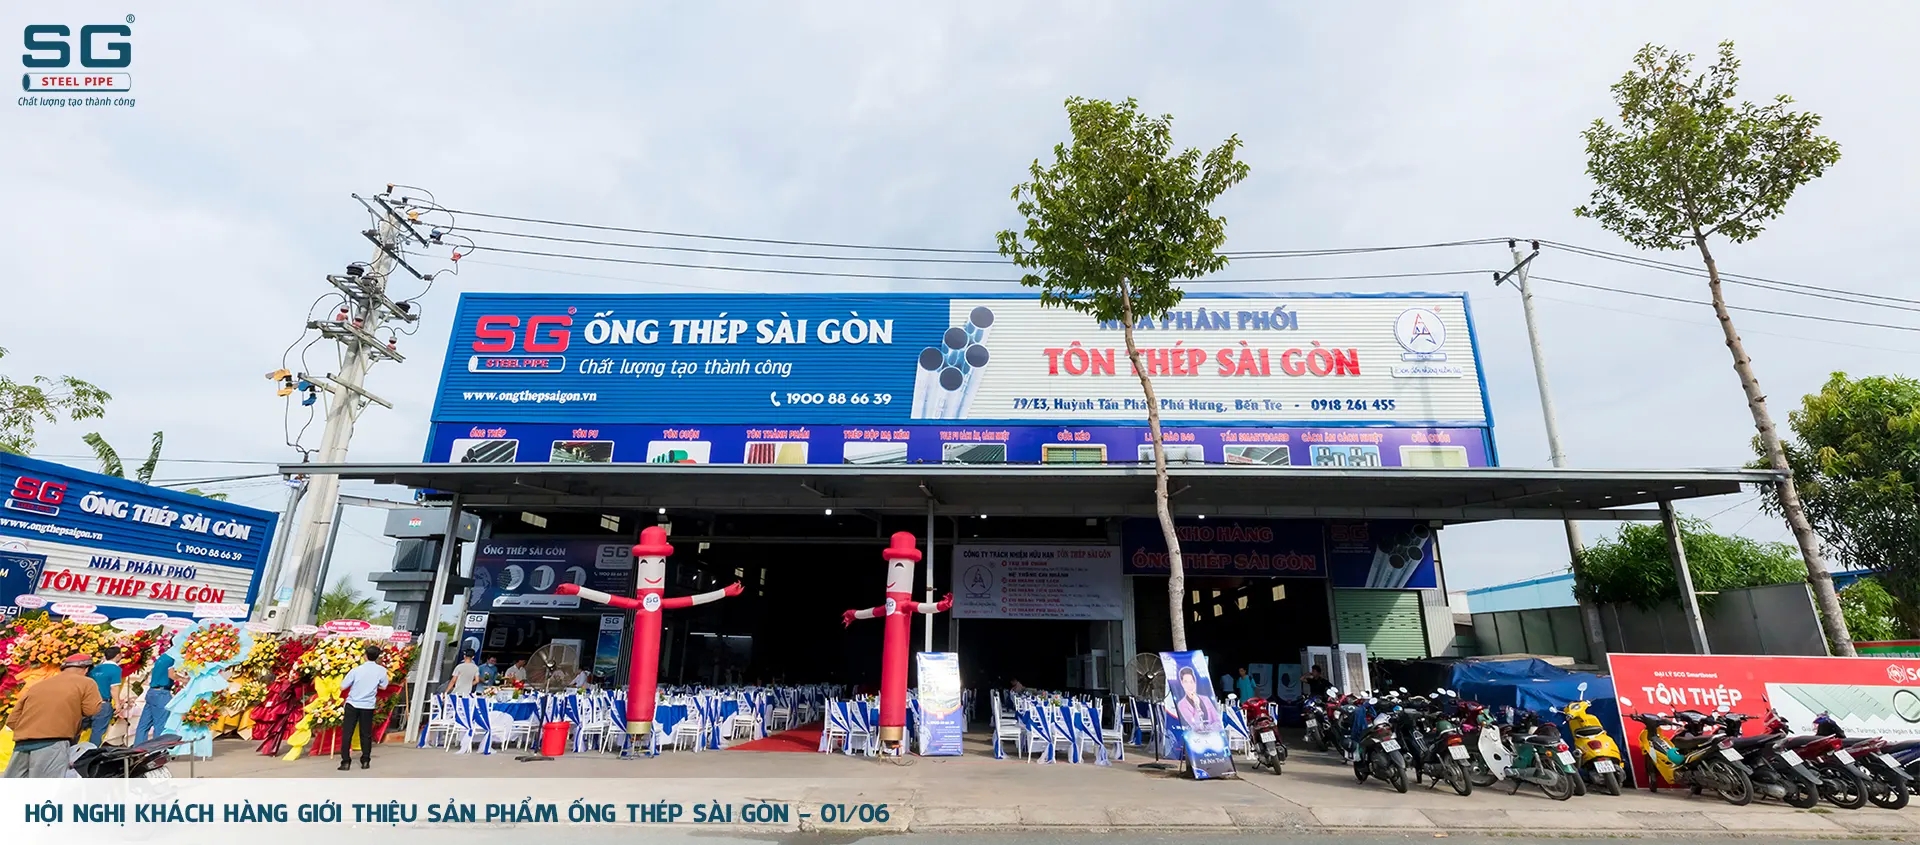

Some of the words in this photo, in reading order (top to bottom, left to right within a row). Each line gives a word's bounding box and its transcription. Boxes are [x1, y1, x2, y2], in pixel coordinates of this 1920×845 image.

[1161, 307, 1231, 331] PHÂN
[1237, 304, 1299, 331] PHỐI
[472, 315, 573, 353] SG
[584, 310, 659, 345] ỐNG
[669, 311, 748, 345] THÉP
[756, 311, 808, 345] SÀI
[816, 311, 894, 345] GÒN
[485, 359, 521, 368] STEEL
[524, 359, 549, 368] PIPE
[579, 357, 615, 375] Chất
[619, 358, 666, 378] lượng
[671, 360, 698, 378] tạo
[704, 358, 750, 375] thành
[754, 359, 793, 378] công
[1043, 341, 1116, 376] TÔN
[1125, 341, 1207, 376] THÉP
[1215, 341, 1272, 376] SÀI
[1280, 341, 1361, 376] GÒN
[463, 390, 597, 404] www.ongthepsaigon.vn
[786, 392, 825, 405] 1900
[827, 392, 847, 405] 88
[850, 392, 870, 405] 66
[872, 392, 892, 405] 39
[1013, 397, 1050, 411] 79/E3,
[1054, 398, 1094, 412] Huỳnh
[1099, 398, 1119, 410] Tấn
[1124, 398, 1147, 410] Phá
[1161, 398, 1184, 410] Phú
[1189, 399, 1228, 412] Hưng,
[1235, 399, 1259, 411] Bến
[1263, 400, 1282, 411] Tre
[1311, 399, 1342, 411] 0918
[1346, 399, 1368, 411] 261
[1372, 399, 1395, 411] 455
[469, 426, 486, 438] ỐNG
[487, 427, 507, 438] THÉP
[572, 428, 587, 438] TÔN
[663, 429, 678, 439] TÔN
[746, 428, 761, 439] TÔN
[762, 428, 788, 439] THÀNH
[843, 429, 863, 439] THÉP
[11, 476, 67, 505] SG
[80, 491, 128, 518] ỐNG
[132, 504, 179, 527] THÉP
[180, 513, 211, 533] SÀI
[212, 519, 251, 540] GÒN
[0, 518, 103, 540] www.ongthepsaigon.vn
[1174, 526, 1215, 542] KHO
[1217, 522, 1273, 543] HÀNG
[1331, 524, 1370, 542] SG
[185, 545, 208, 556] 1900
[208, 548, 219, 558] 88
[220, 550, 231, 560] 66
[231, 551, 242, 561] 39
[484, 544, 504, 555] ỐNG
[506, 545, 527, 556] THÉP
[529, 546, 543, 556] SÀI
[546, 546, 566, 556] GÒN
[602, 546, 629, 558] SG
[88, 556, 120, 571] NHÀ
[125, 560, 164, 576] PHÂN
[166, 565, 197, 579] PHỐI
[1181, 550, 1230, 570] THÉP
[1235, 549, 1270, 570] SÀI
[1272, 550, 1316, 571] GÒN
[40, 569, 91, 592] TÔN
[95, 576, 146, 597] THÉP
[148, 580, 181, 601] SÀI
[184, 584, 225, 604] GÒN
[1642, 683, 1687, 705] TÔN
[1688, 684, 1743, 707] THÉP
